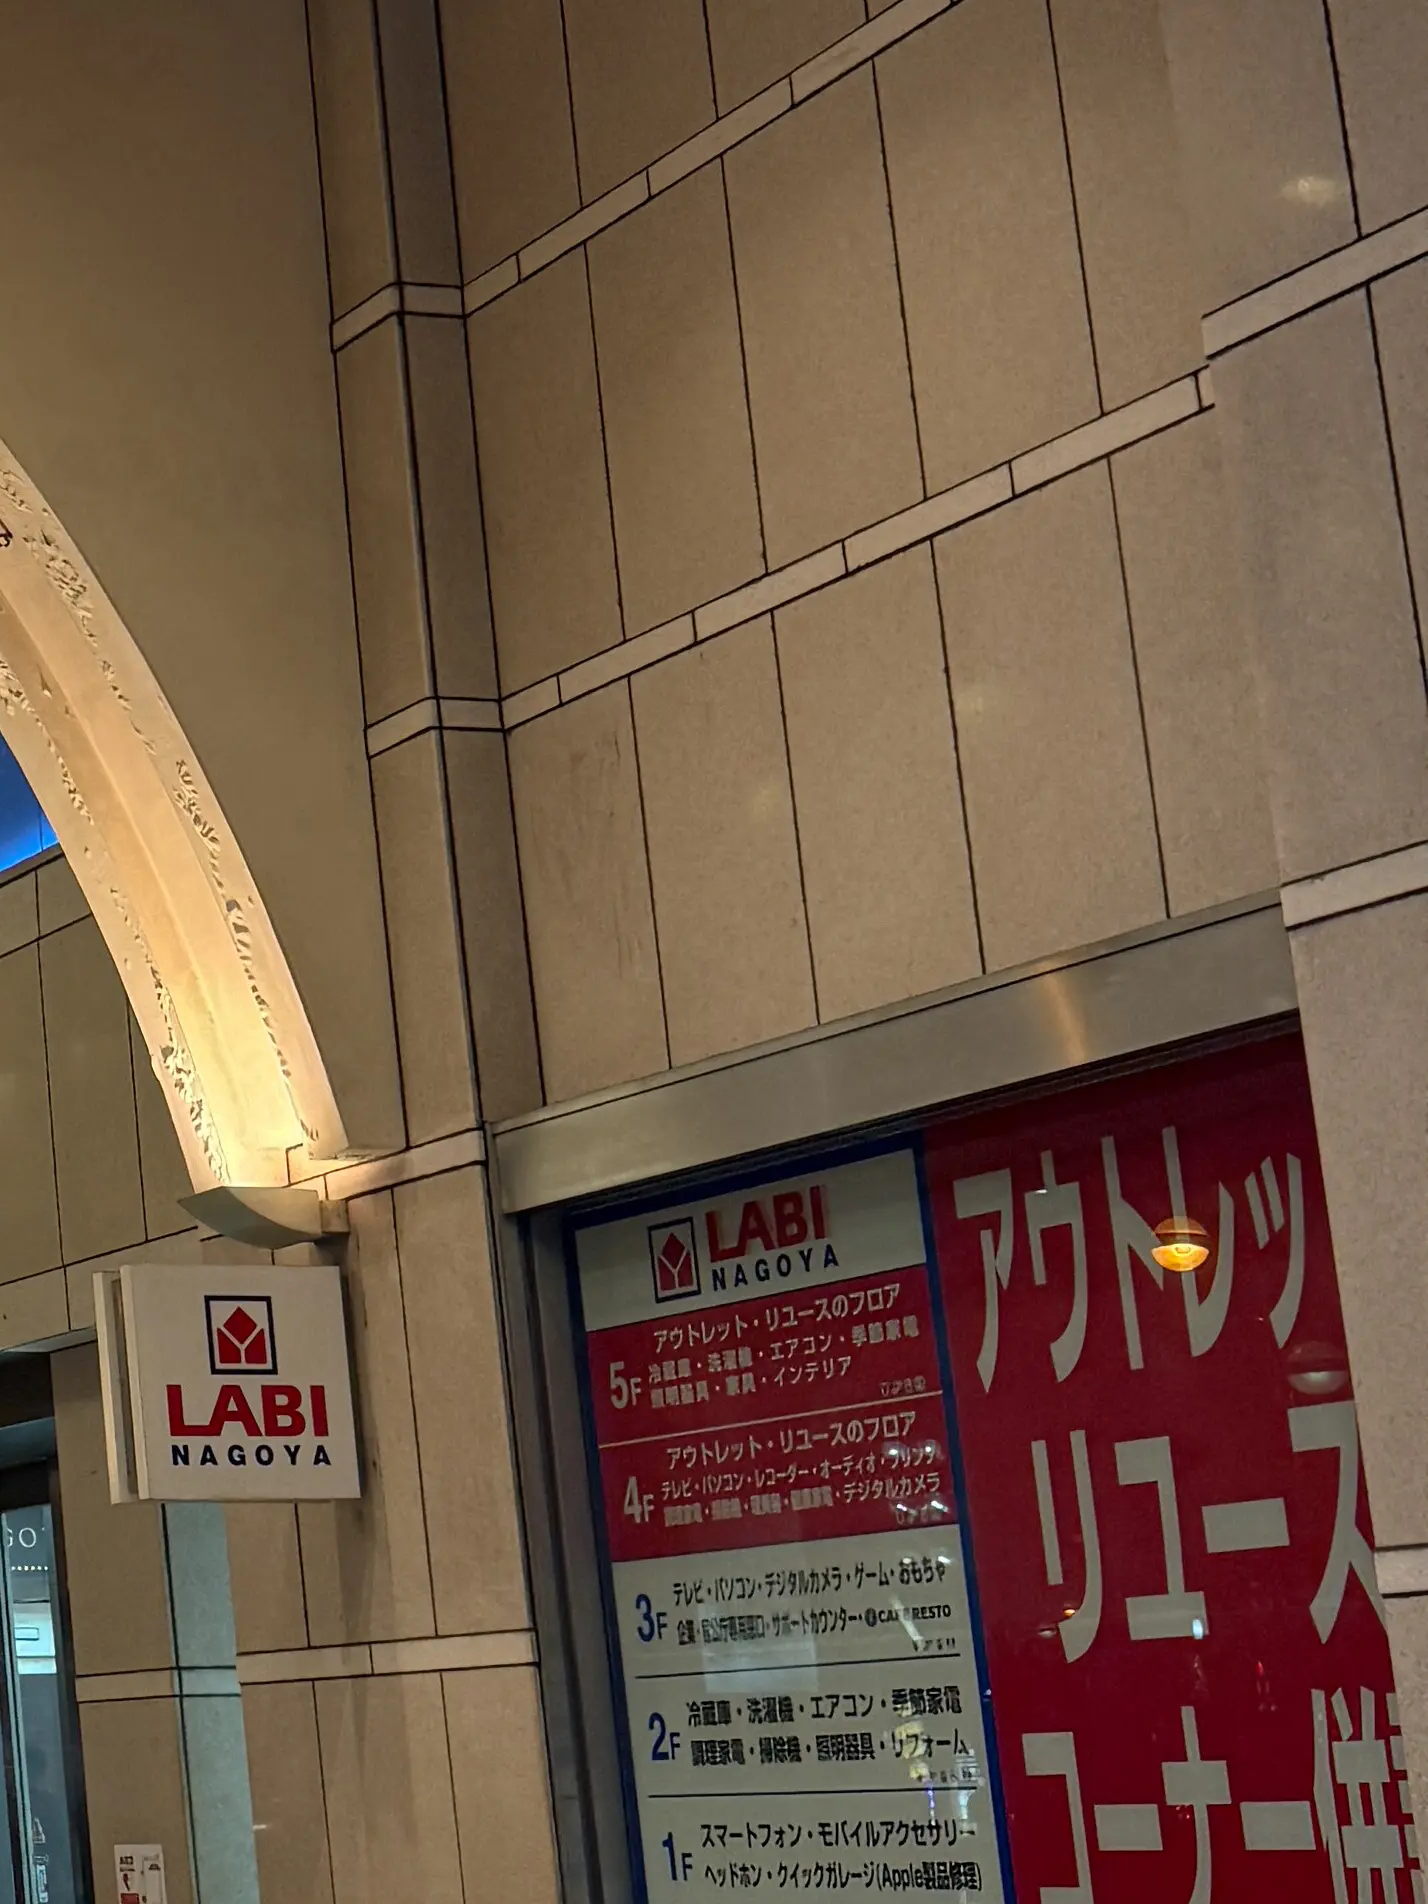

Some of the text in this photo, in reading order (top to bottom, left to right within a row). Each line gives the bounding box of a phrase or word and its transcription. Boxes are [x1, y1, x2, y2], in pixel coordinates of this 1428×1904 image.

[705, 1184, 829, 1263] LABI
[711, 1243, 840, 1292] NAGOYA
[653, 1283, 901, 1354] アウトレット・リユースのフロア
[609, 1361, 642, 1409] 5F
[166, 1384, 329, 1437] LABI
[171, 1444, 332, 1466] NAGOYA
[666, 1411, 917, 1470] アウトレット・リユースのフロア
[623, 1476, 655, 1524] 4F
[1030, 1400, 1389, 1664] リユース
[635, 1593, 668, 1643] 3F
[648, 1711, 680, 1761] 2F
[662, 1831, 693, 1882] 1F
[700, 1819, 976, 1849] スマートフォン・モバイルアクセサリー
